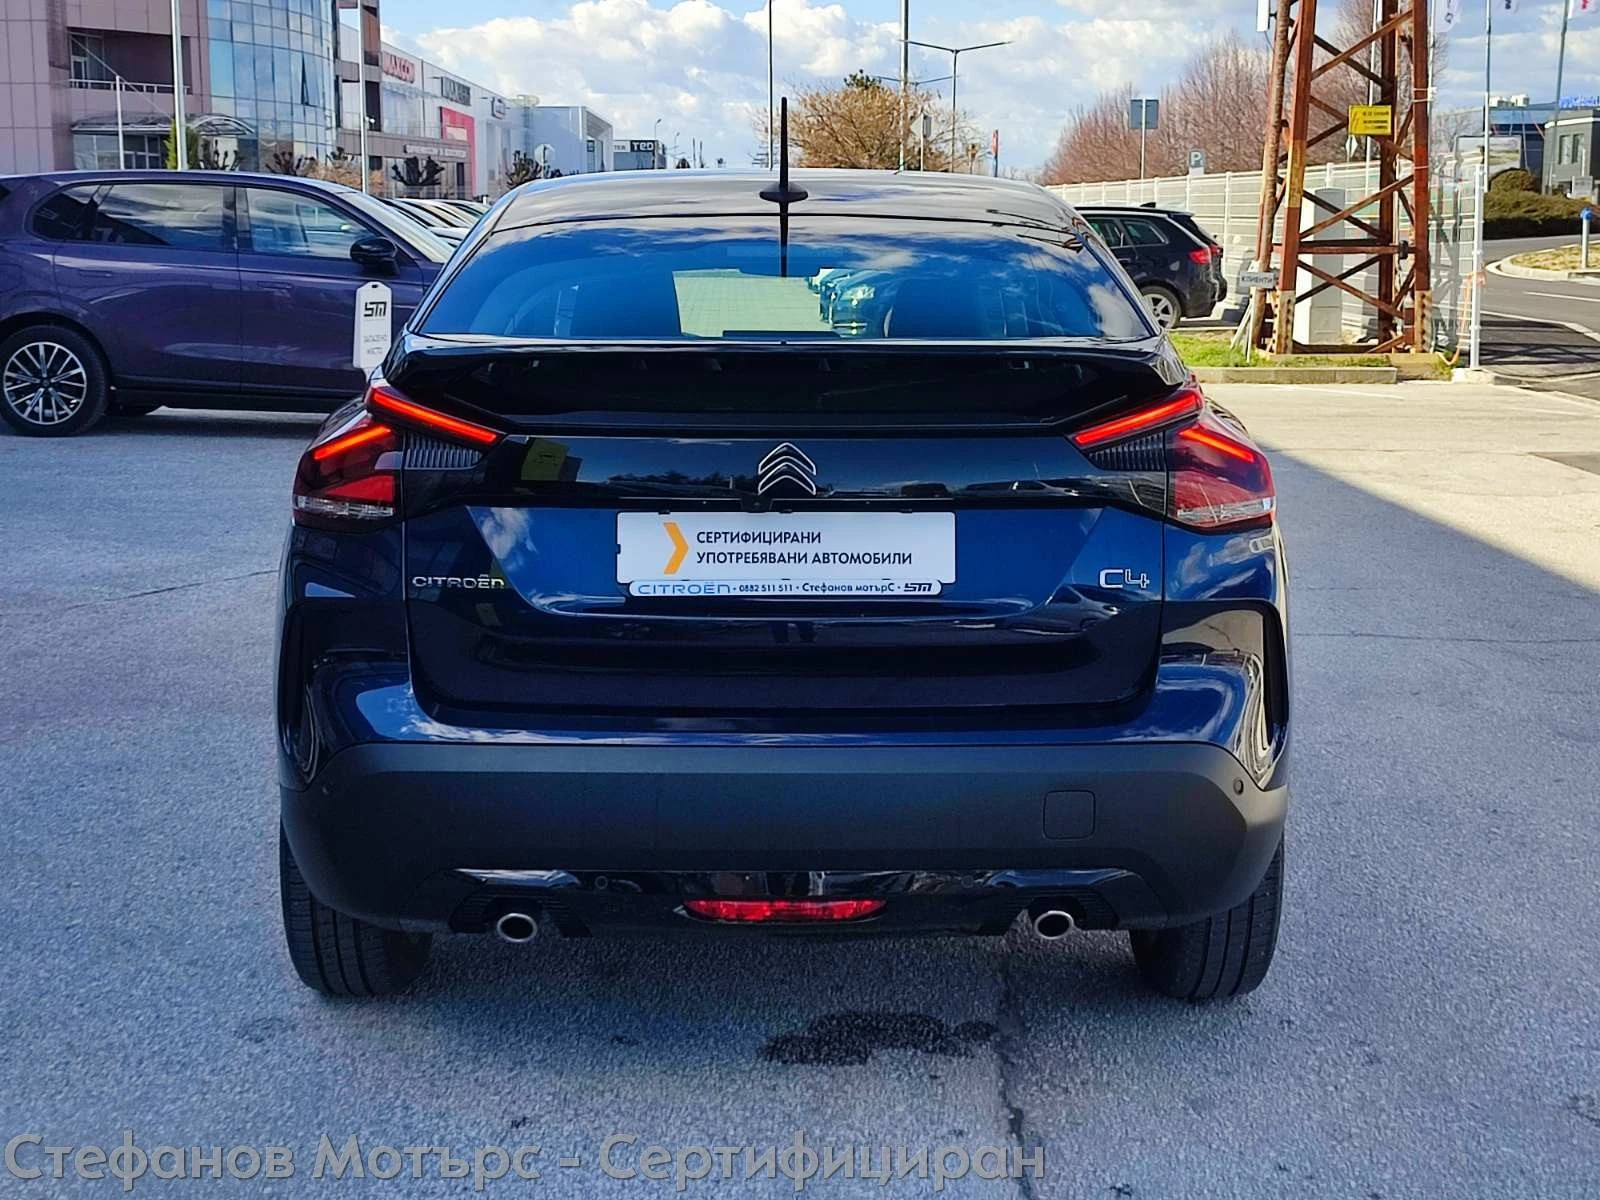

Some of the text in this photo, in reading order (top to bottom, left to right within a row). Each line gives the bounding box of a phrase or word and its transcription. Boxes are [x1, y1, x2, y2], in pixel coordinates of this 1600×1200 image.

[696, 531, 821, 546] СЕРТИФИЦИРАНИ
[696, 551, 913, 565] УПОТРЕБЯВАНИ АВТОМОБИЛИ
[1099, 568, 1151, 589] C4
[738, 584, 759, 592] 0882
[761, 584, 776, 592] 511
[778, 584, 793, 592] 511
[802, 582, 853, 593] Стефанов
